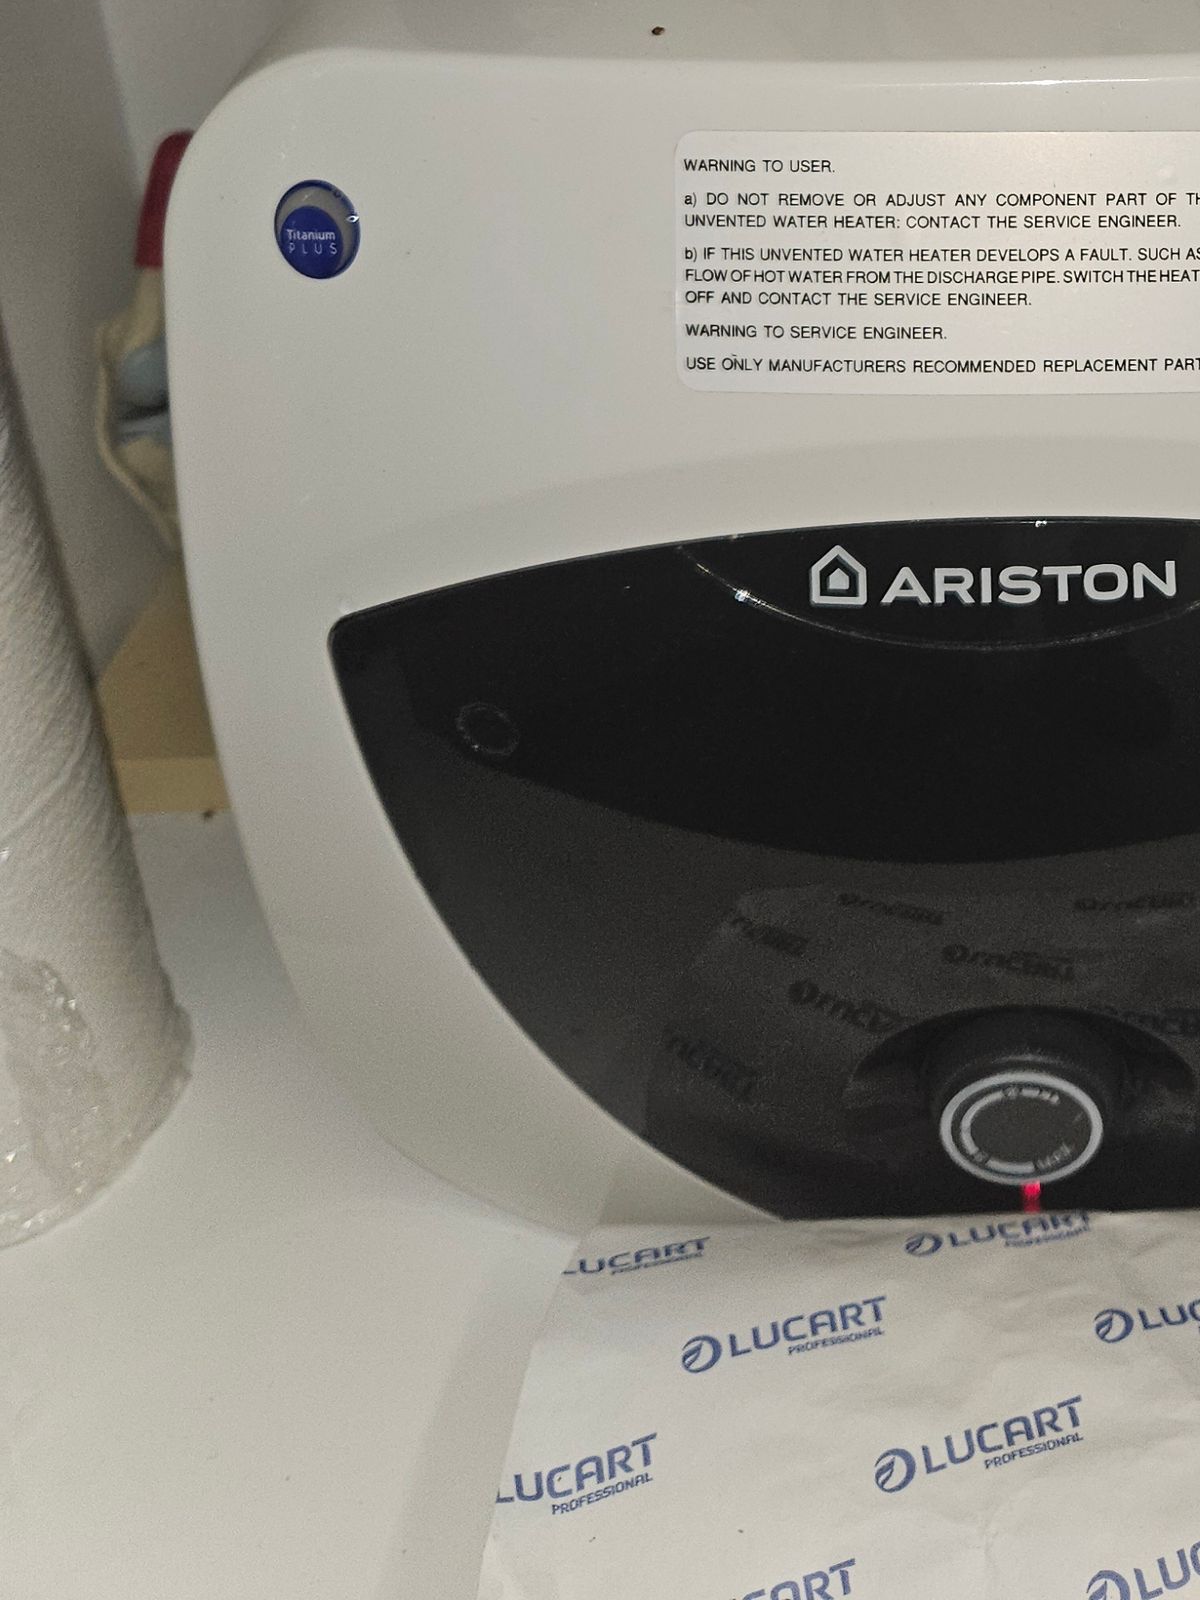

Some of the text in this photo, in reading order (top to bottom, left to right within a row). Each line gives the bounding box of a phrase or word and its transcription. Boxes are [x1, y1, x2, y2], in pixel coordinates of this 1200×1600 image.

[683, 158, 835, 173] WARNING TO USER.
[684, 192, 697, 208] a)
[706, 192, 729, 206] DO
[737, 192, 770, 206] NOT
[778, 193, 845, 207] REMOVE
[853, 193, 877, 207] OR
[885, 193, 946, 207] ADJUST
[954, 193, 987, 207] ANY
[995, 193, 1097, 207] COMPONENT
[1106, 192, 1148, 206] PART
[1155, 192, 1177, 206] OF
[684, 214, 1181, 229] UNVENTED WATER HEATER: CONTACT THE SERVICE ENGINEER.
[286, 229, 336, 241] Titanium
[288, 242, 338, 254] PLUS
[684, 247, 697, 263] b)
[703, 247, 716, 260] IF
[720, 247, 755, 261] THIS
[760, 248, 843, 262] UNVENTED
[848, 248, 904, 262] WATER
[909, 249, 971, 262] HEATER
[976, 248, 1060, 262] DEVELOPS
[1064, 248, 1075, 262] A
[1080, 248, 1132, 261] FAULT.
[1137, 247, 1181, 261] SUCH
[685, 268, 728, 282] FLOW
[730, 269, 752, 282] OF
[754, 269, 786, 283] HOT
[788, 270, 843, 284] WATER
[846, 270, 891, 284] FROM
[893, 271, 924, 284] THE
[927, 270, 1019, 284] DISCHARGE
[1021, 270, 1060, 284] PIPE.
[1063, 270, 1124, 284] SWITCH
[1126, 269, 1157, 283] THE
[684, 290, 1032, 306] OFF AND CONTACT THE SERVICE ENGINEER.
[685, 323, 947, 340] WARNING TO SERVICE ENGINEER.
[686, 356, 716, 370] USE
[721, 357, 763, 371] ONLY
[769, 359, 907, 373] MANUFACTURERS
[913, 359, 1036, 373] RECOMMENDED
[1043, 358, 1158, 373] REPLACEMENT
[880, 559, 1177, 605] ARISTON
[728, 1295, 887, 1358] LUCART
[921, 1394, 1083, 1477] LUCART
[983, 1430, 1085, 1470] PROFESSIONAL
[551, 1472, 654, 1515] PROFESSIONAL
